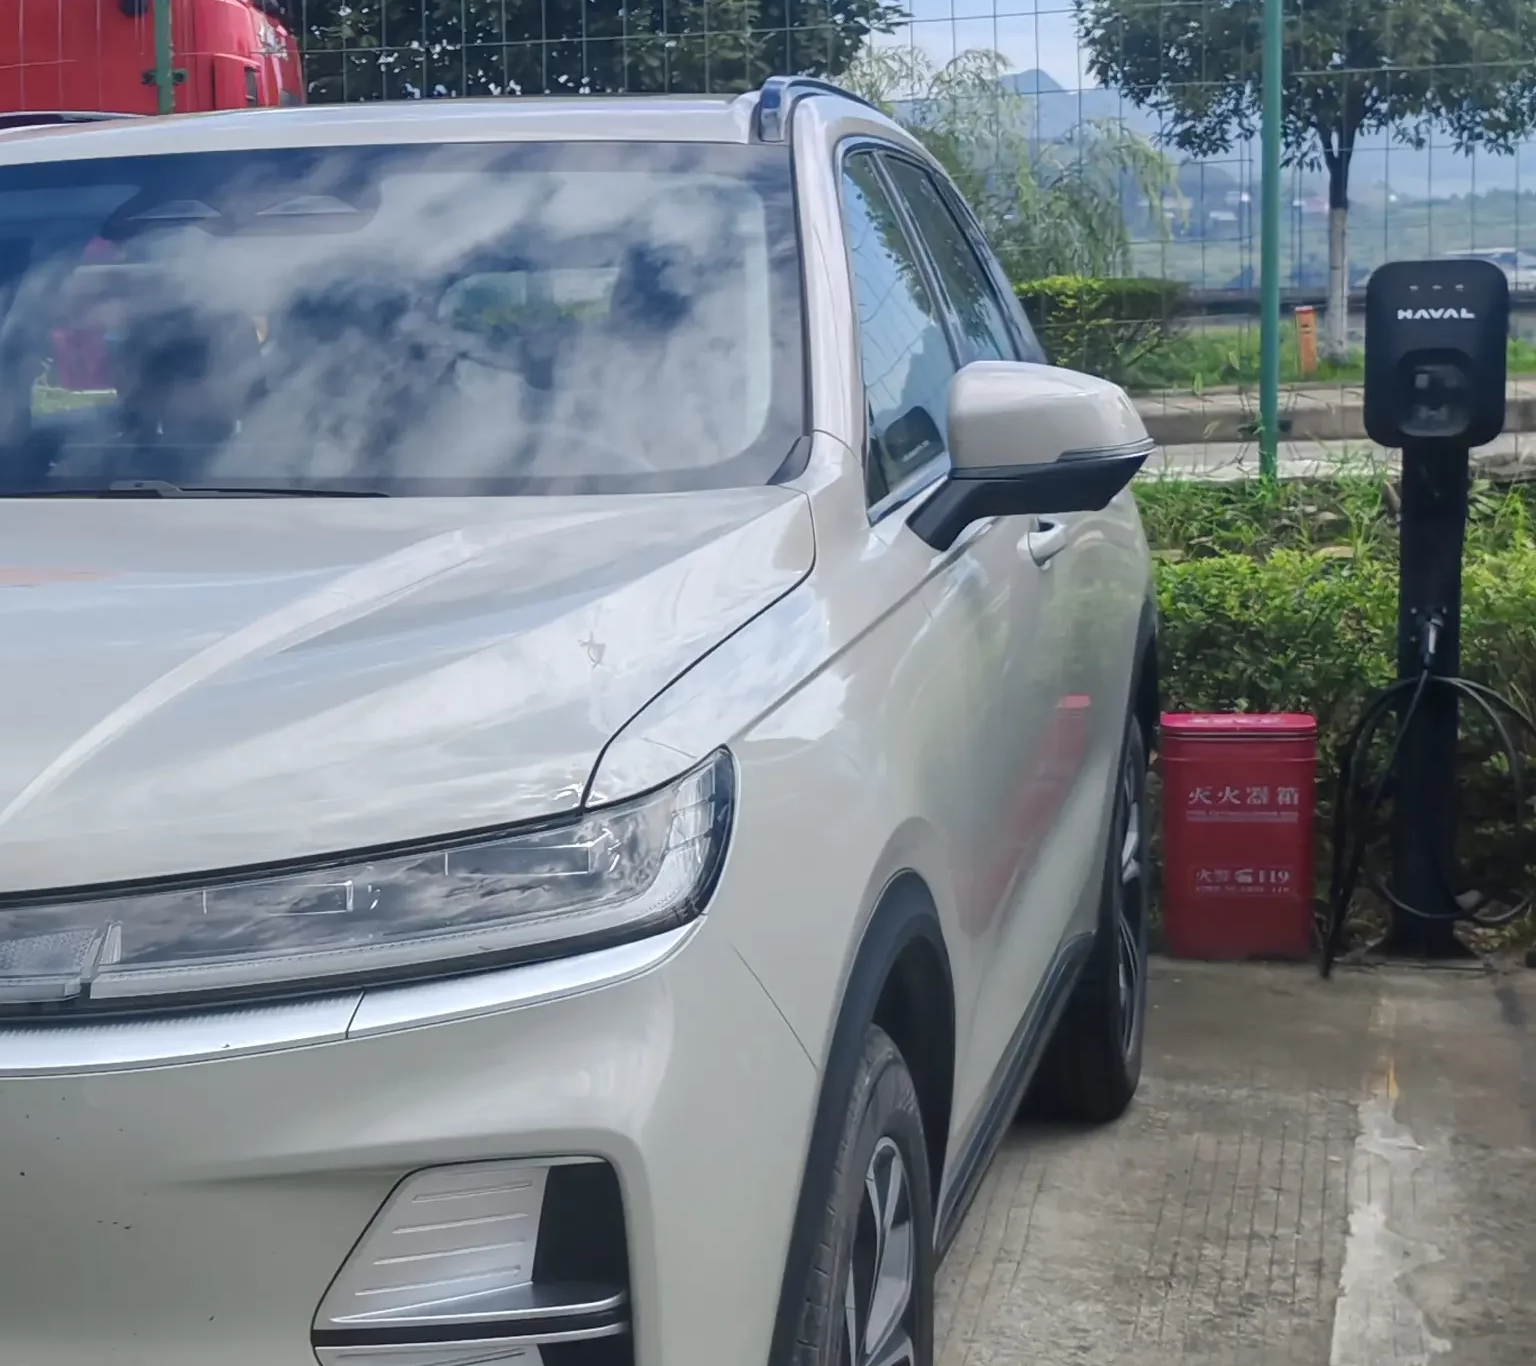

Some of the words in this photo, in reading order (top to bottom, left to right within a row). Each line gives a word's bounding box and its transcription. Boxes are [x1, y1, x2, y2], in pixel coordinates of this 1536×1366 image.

[1397, 308, 1476, 320] HAVAL
[1188, 786, 1300, 805] 灭火器箱
